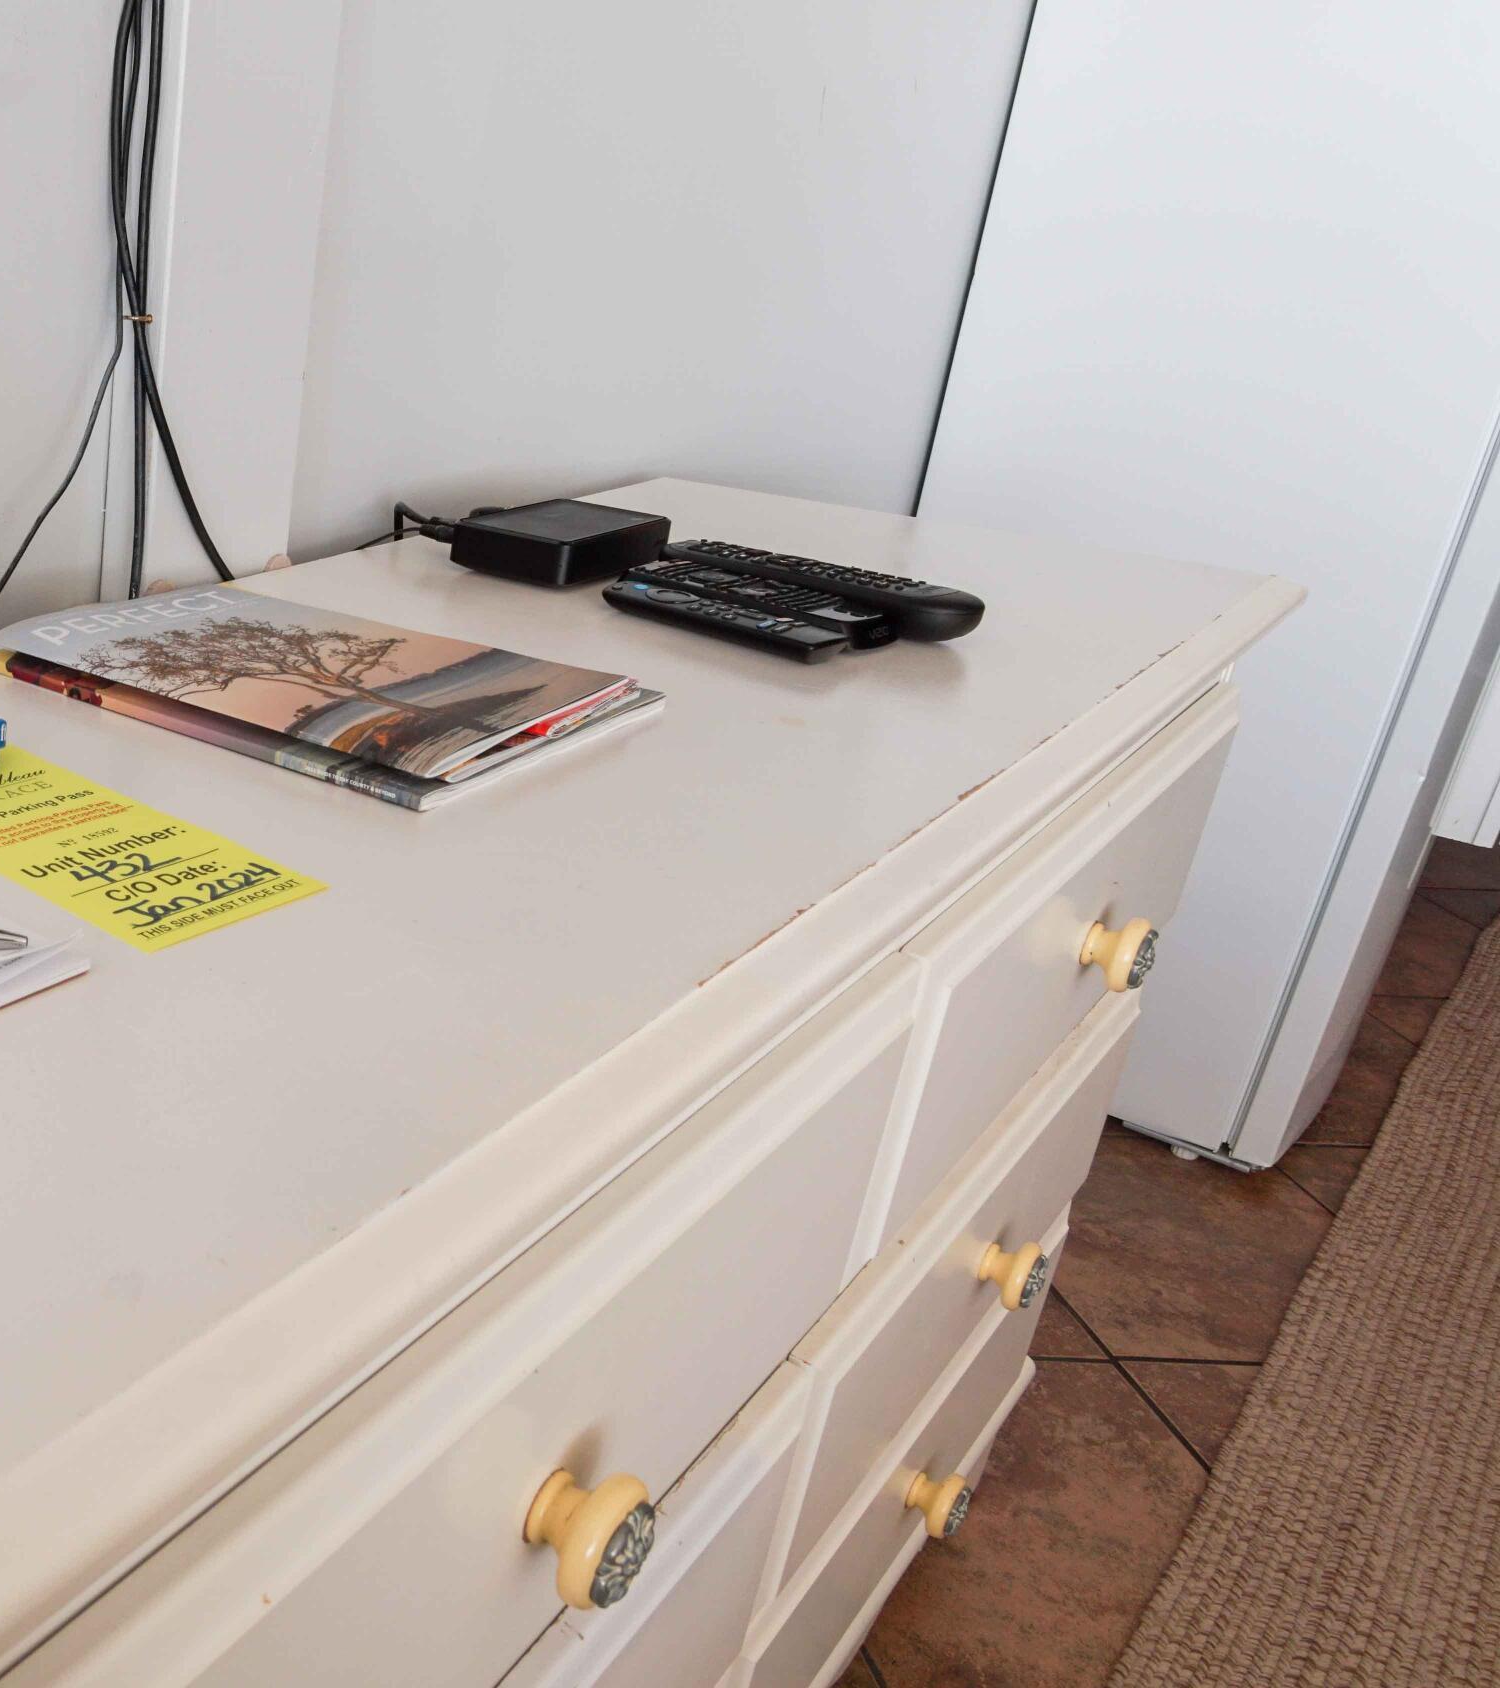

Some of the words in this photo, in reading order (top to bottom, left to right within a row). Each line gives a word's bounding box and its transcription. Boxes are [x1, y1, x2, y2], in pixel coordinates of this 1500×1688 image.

[31, 591, 238, 646] PERFECT
[56, 788, 94, 803] Pass
[20, 855, 82, 880] Unit
[83, 826, 188, 863] Number:
[69, 852, 182, 885] 432
[104, 878, 158, 902] C/O
[157, 860, 227, 887] Date:
[112, 896, 201, 929] Jan
[196, 862, 281, 901] 2024
[137, 922, 172, 940] THIS
[170, 910, 203, 931] SIDE
[202, 900, 240, 921] MUST
[238, 889, 273, 906] FACE
[270, 878, 302, 892] OUT
